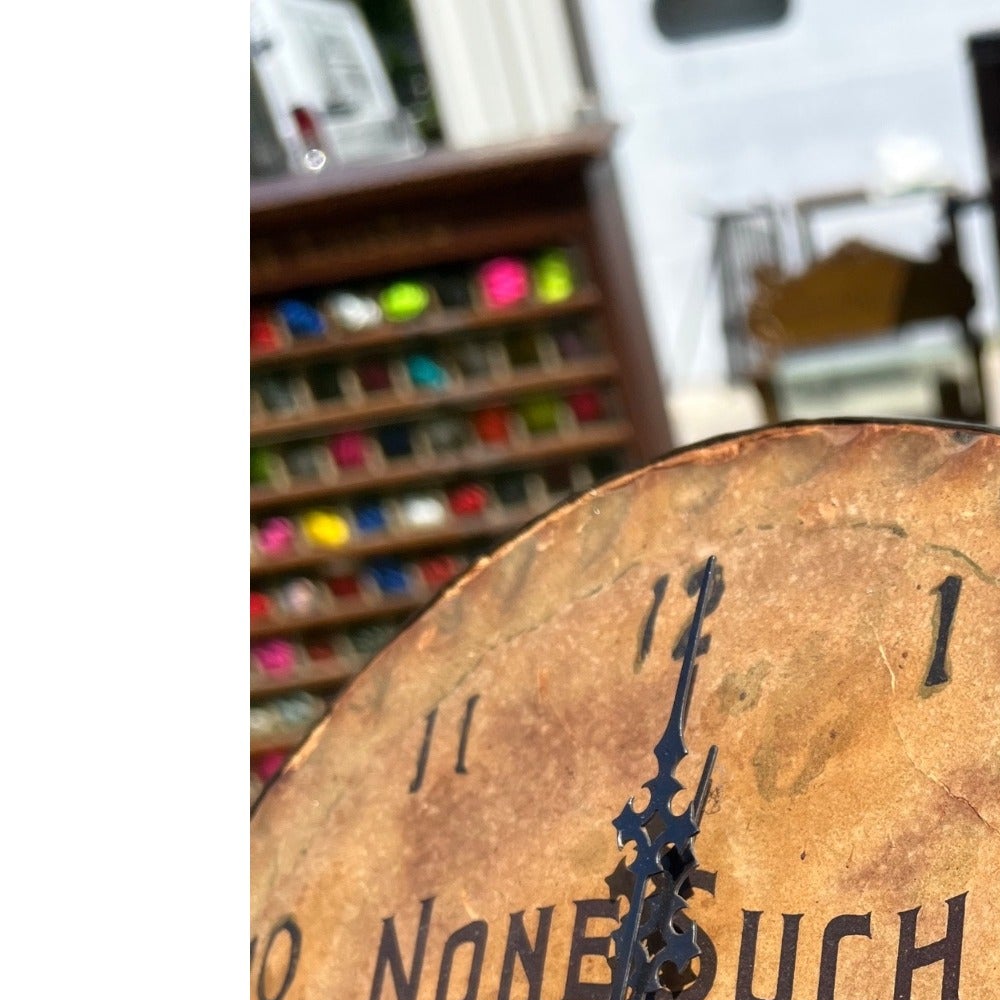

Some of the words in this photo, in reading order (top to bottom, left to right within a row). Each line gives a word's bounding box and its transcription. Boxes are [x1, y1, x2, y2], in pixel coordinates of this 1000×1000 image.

[637, 564, 726, 664] 12
[923, 575, 964, 688] 1
[408, 693, 481, 794] 11
